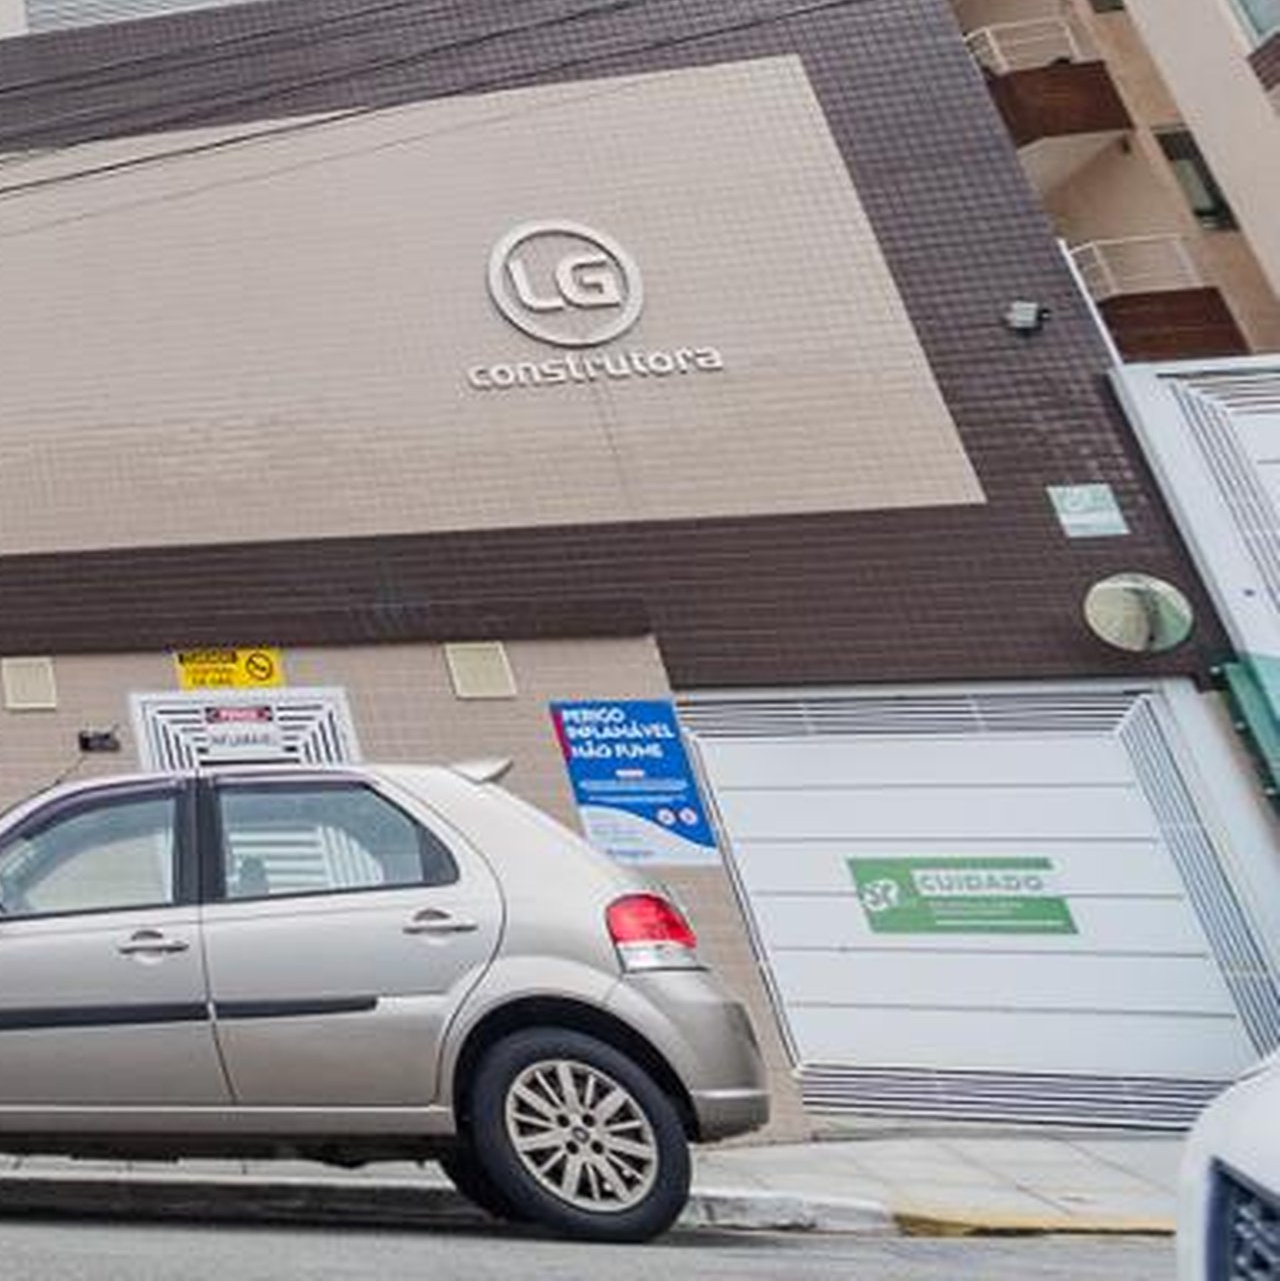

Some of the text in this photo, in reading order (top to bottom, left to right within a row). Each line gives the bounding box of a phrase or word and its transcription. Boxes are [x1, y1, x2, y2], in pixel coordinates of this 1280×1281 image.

[505, 252, 622, 314] LG
[466, 345, 724, 391] construtora
[919, 874, 1046, 892] CUIDADO
